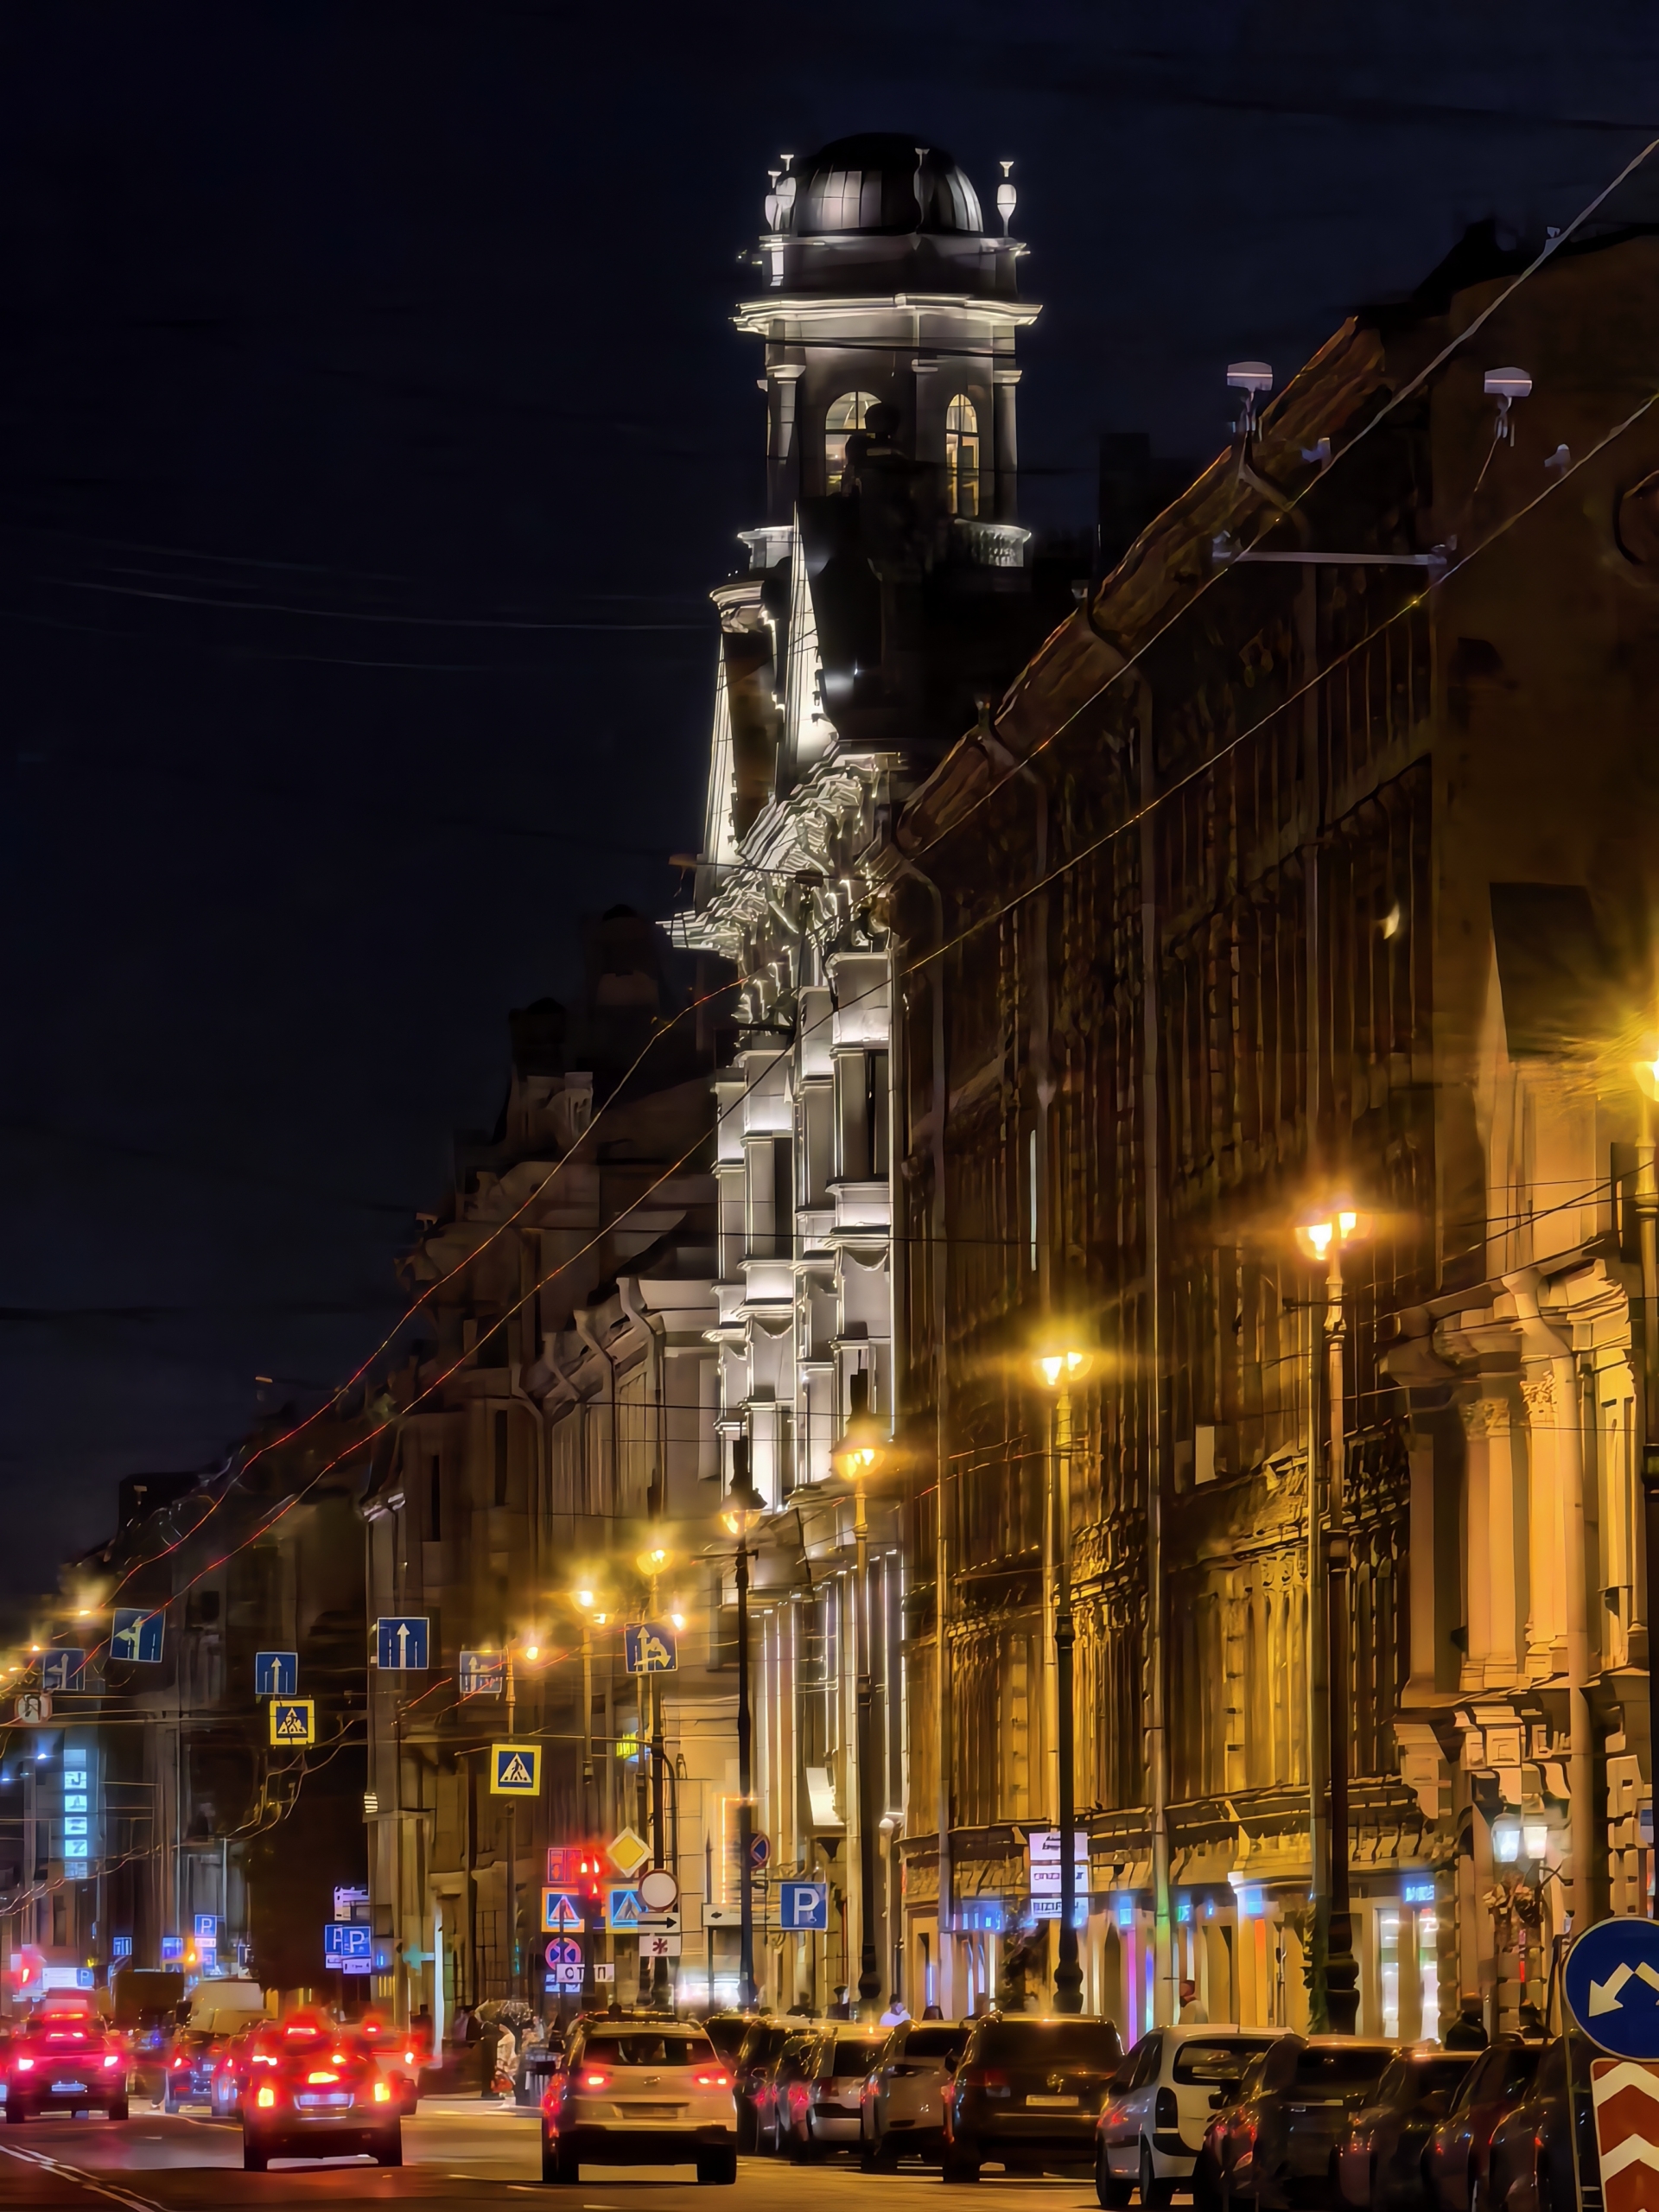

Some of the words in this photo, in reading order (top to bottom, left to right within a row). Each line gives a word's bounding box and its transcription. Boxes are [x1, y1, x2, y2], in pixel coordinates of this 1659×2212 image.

[793, 1888, 819, 1925] P
[200, 1918, 213, 1935] P
[349, 1930, 365, 1953] P
[565, 1967, 606, 1980] СТП
